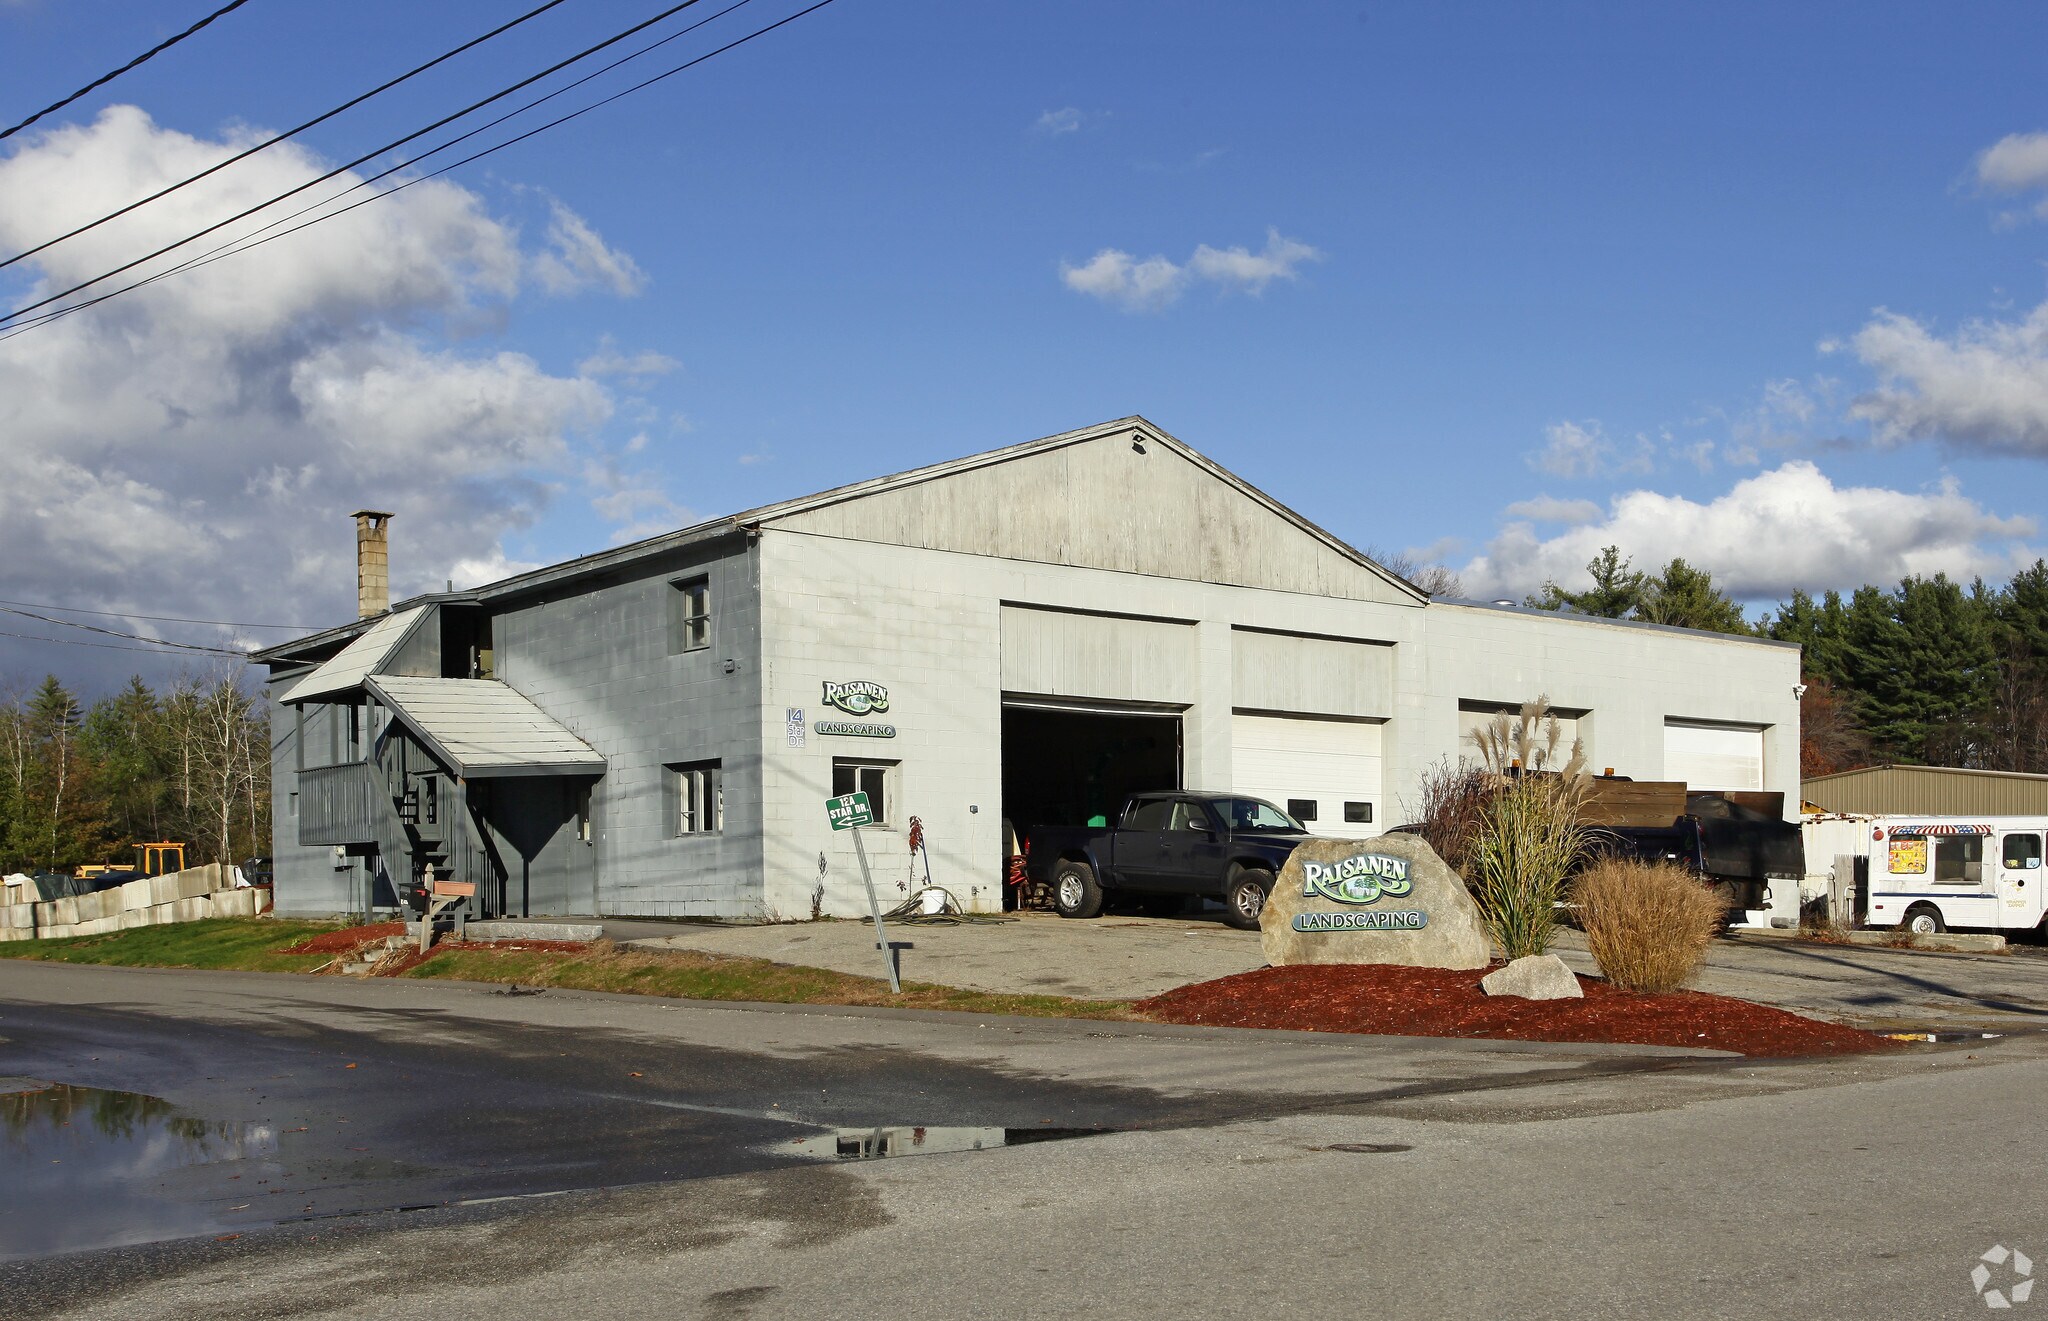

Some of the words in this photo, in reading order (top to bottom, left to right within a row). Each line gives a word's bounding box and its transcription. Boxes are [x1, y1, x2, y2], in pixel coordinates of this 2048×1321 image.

[824, 682, 888, 703] RAISANEN
[788, 708, 804, 723] 14
[788, 724, 805, 736] Star
[820, 722, 892, 735] LANDSCAPING
[839, 796, 856, 807] 12A
[829, 806, 853, 819] STAR
[854, 803, 870, 814] DR.
[1303, 855, 1407, 893] RAISANEN
[1301, 911, 1420, 929] LANDSCAPING
